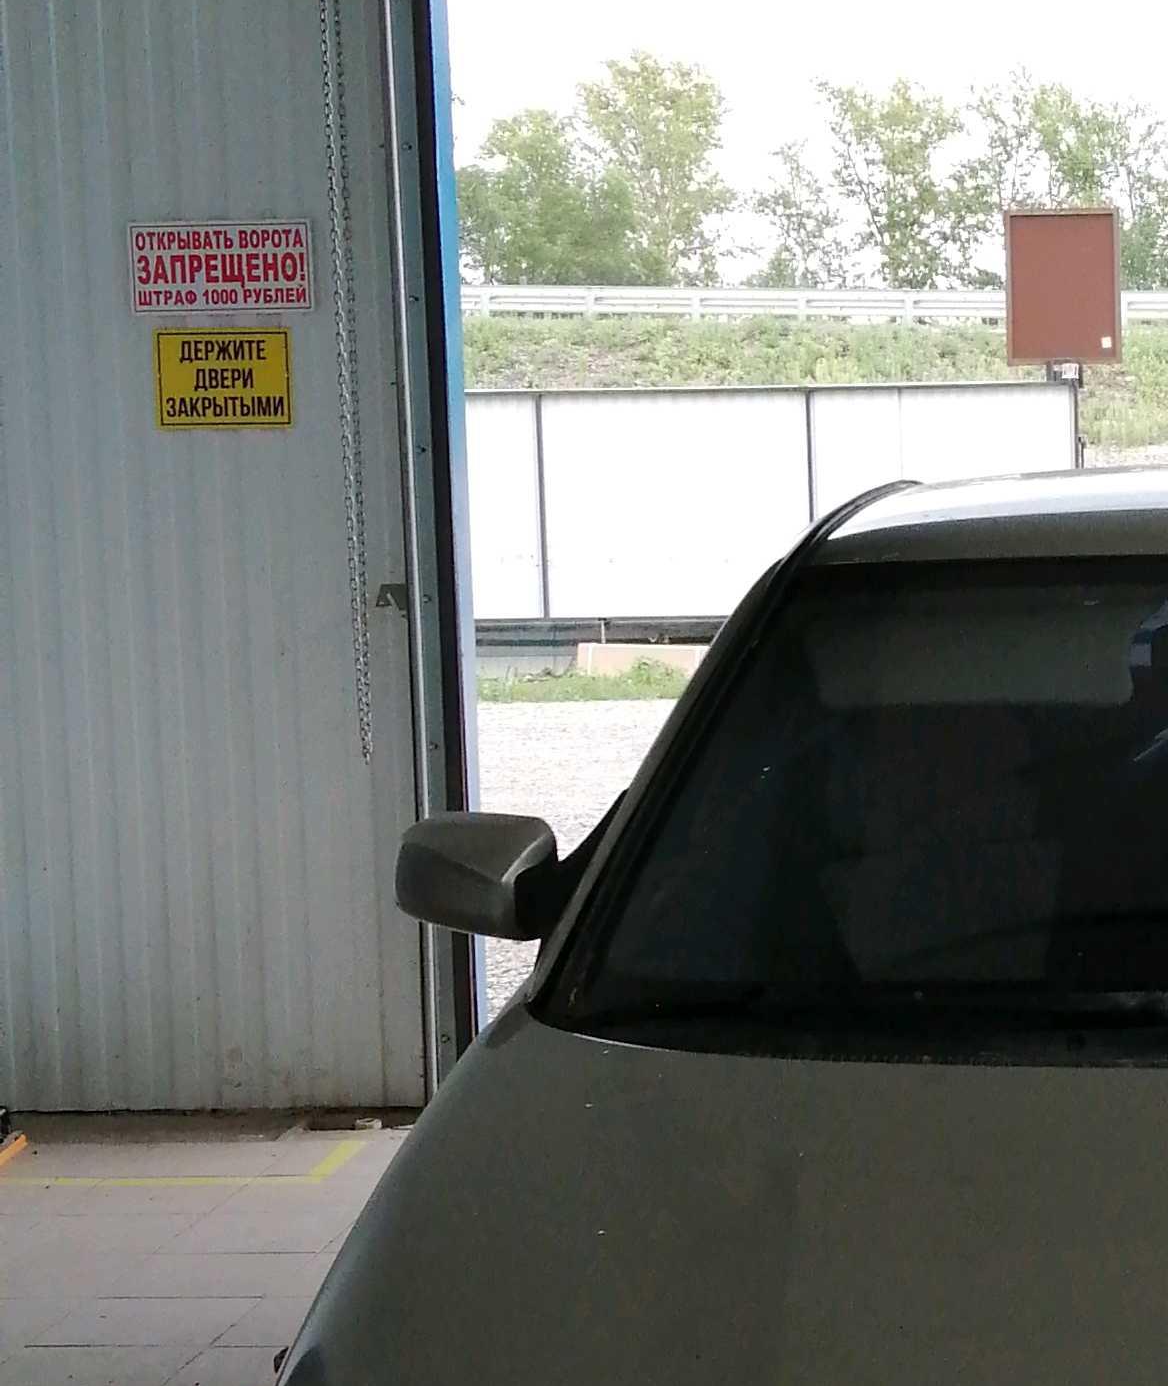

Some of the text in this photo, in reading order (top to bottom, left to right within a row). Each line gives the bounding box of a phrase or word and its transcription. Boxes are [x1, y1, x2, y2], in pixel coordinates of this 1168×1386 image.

[135, 228, 304, 251] ОТКРЫВАТЬ ВОРОТА
[137, 252, 305, 288] ЗАПРЕЩЕНО!
[138, 284, 307, 306] ШТРАФ 1000 РУБЛЕЙ
[179, 340, 267, 363] ДЕРЖИТЕ
[193, 368, 254, 391] ДВЕРИ
[166, 396, 285, 418] ЗАКРЫТЫМИ
